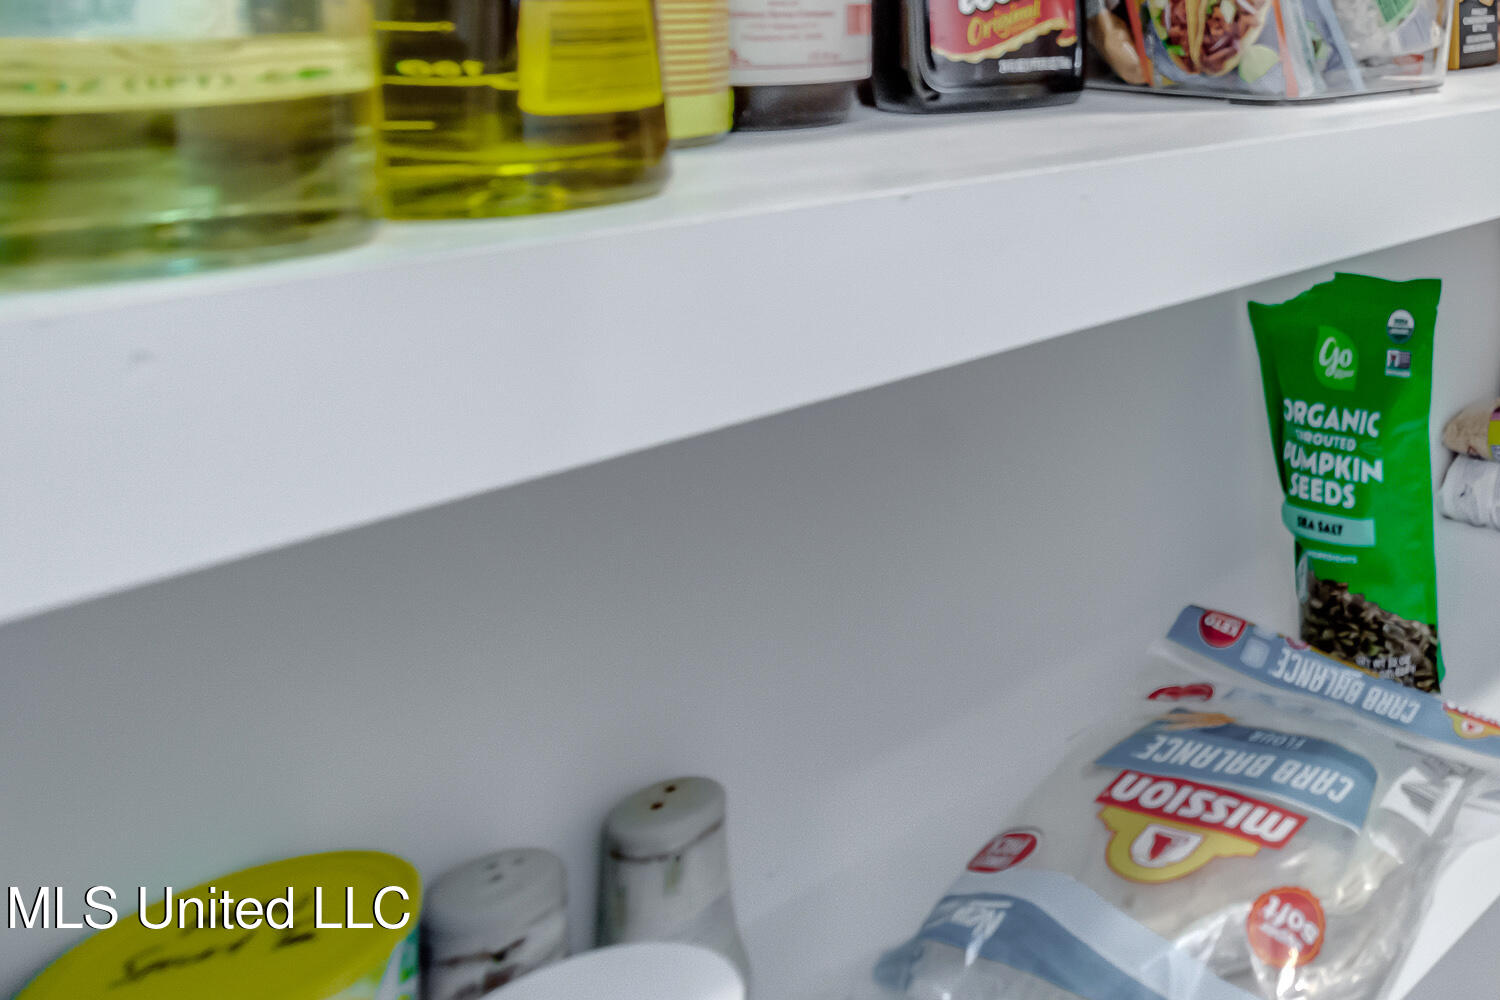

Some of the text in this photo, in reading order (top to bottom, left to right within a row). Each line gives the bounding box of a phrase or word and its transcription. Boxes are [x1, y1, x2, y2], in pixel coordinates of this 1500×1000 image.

[1283, 398, 1381, 438] ORGANIC
[1283, 448, 1384, 484] PUMPKIN
[1290, 472, 1356, 510] SEEDS
[1317, 520, 1344, 537] SALT
[1272, 645, 1368, 704] BALANCE
[1361, 679, 1423, 726] CARB
[1137, 734, 1356, 803] BALANCE CARB
[1110, 771, 1301, 844] MISSION
